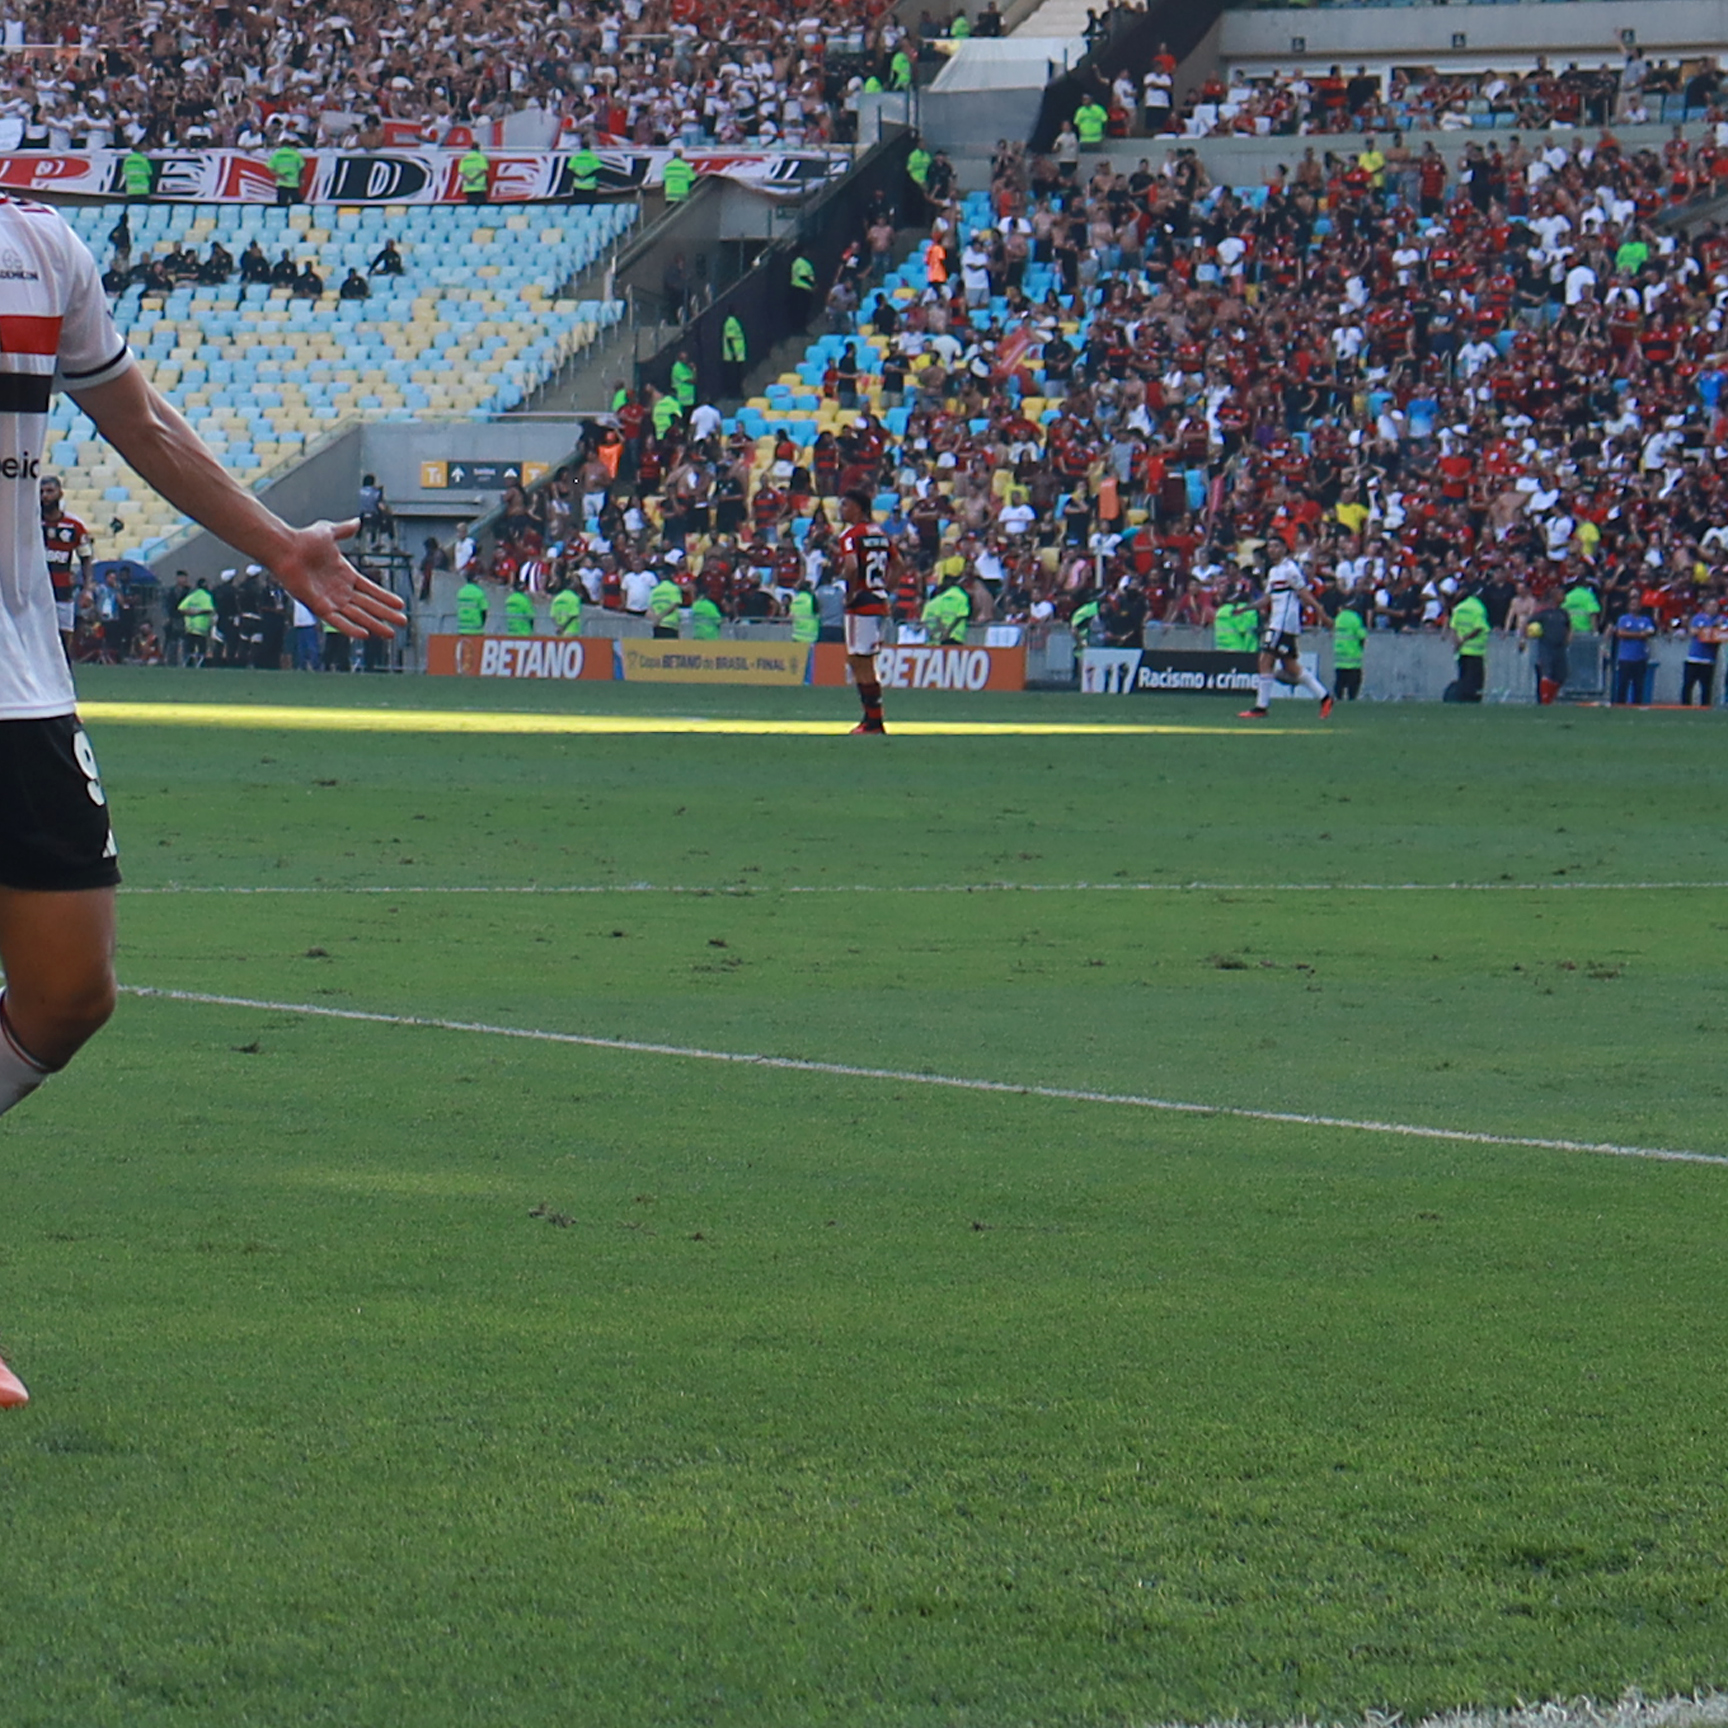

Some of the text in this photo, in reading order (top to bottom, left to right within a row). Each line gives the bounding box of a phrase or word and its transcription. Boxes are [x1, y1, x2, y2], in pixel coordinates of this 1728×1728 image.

[481, 641, 583, 679] BETANO
[662, 654, 701, 670] BETANO
[716, 656, 749, 670] BRASIL
[876, 647, 991, 690] BETANO
[1138, 666, 1204, 689] Racismo
[1216, 668, 1259, 690] crime
[73, 730, 105, 806] 9
